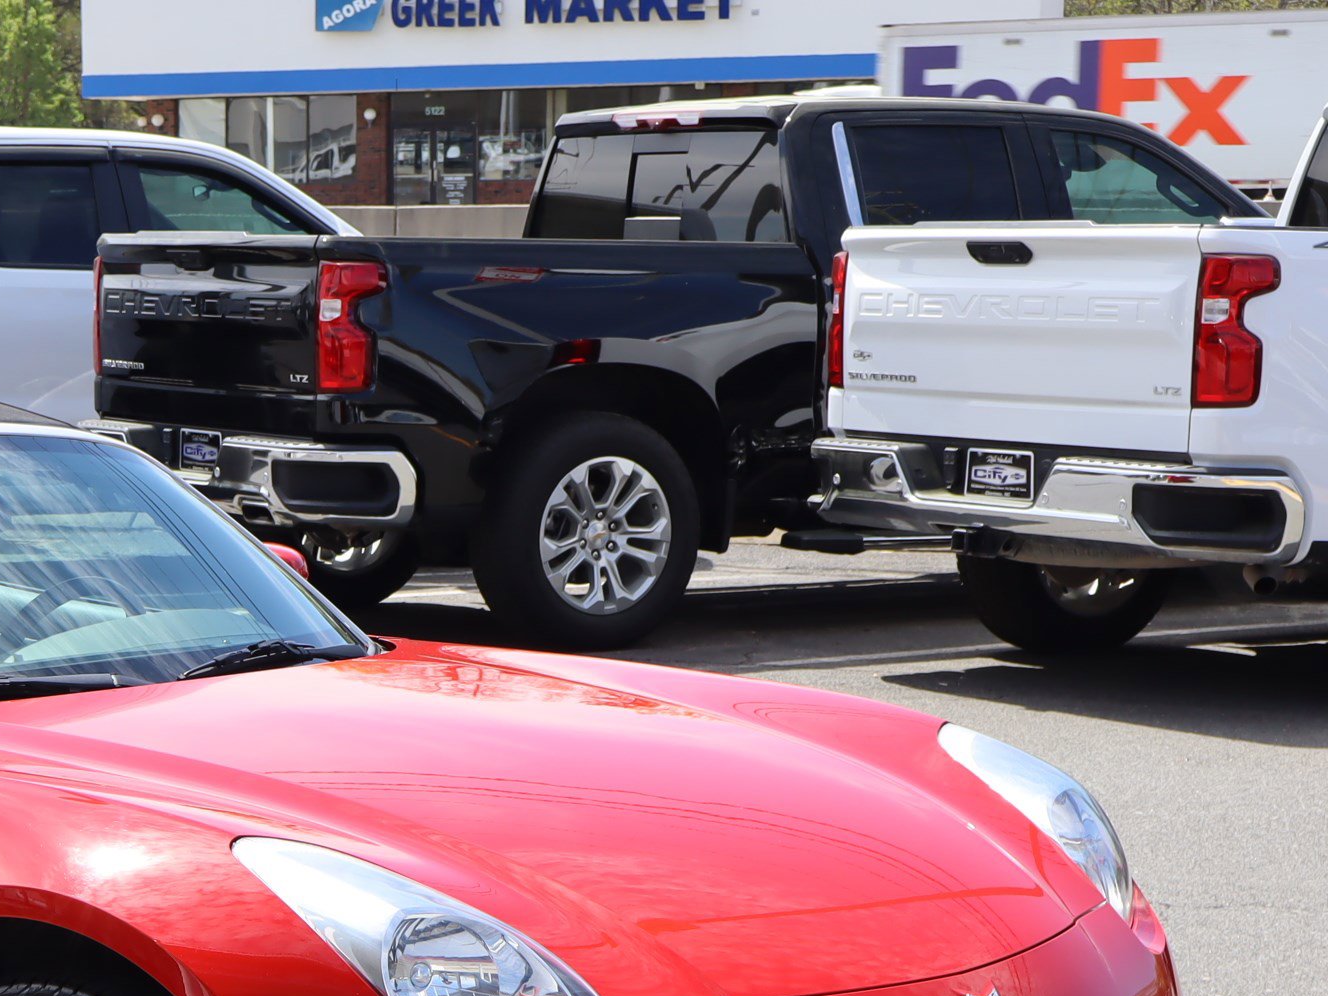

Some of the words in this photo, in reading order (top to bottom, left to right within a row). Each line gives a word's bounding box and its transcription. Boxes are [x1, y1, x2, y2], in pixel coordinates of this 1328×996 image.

[391, 0, 501, 28] GREEK
[425, 106, 445, 116] 5122
[105, 290, 293, 321] CHEVROLET
[858, 292, 1160, 323] CHEVROLET
[290, 374, 309, 384] LTZ
[847, 371, 918, 383] SILVERADO
[1153, 385, 1182, 396] LTZ
